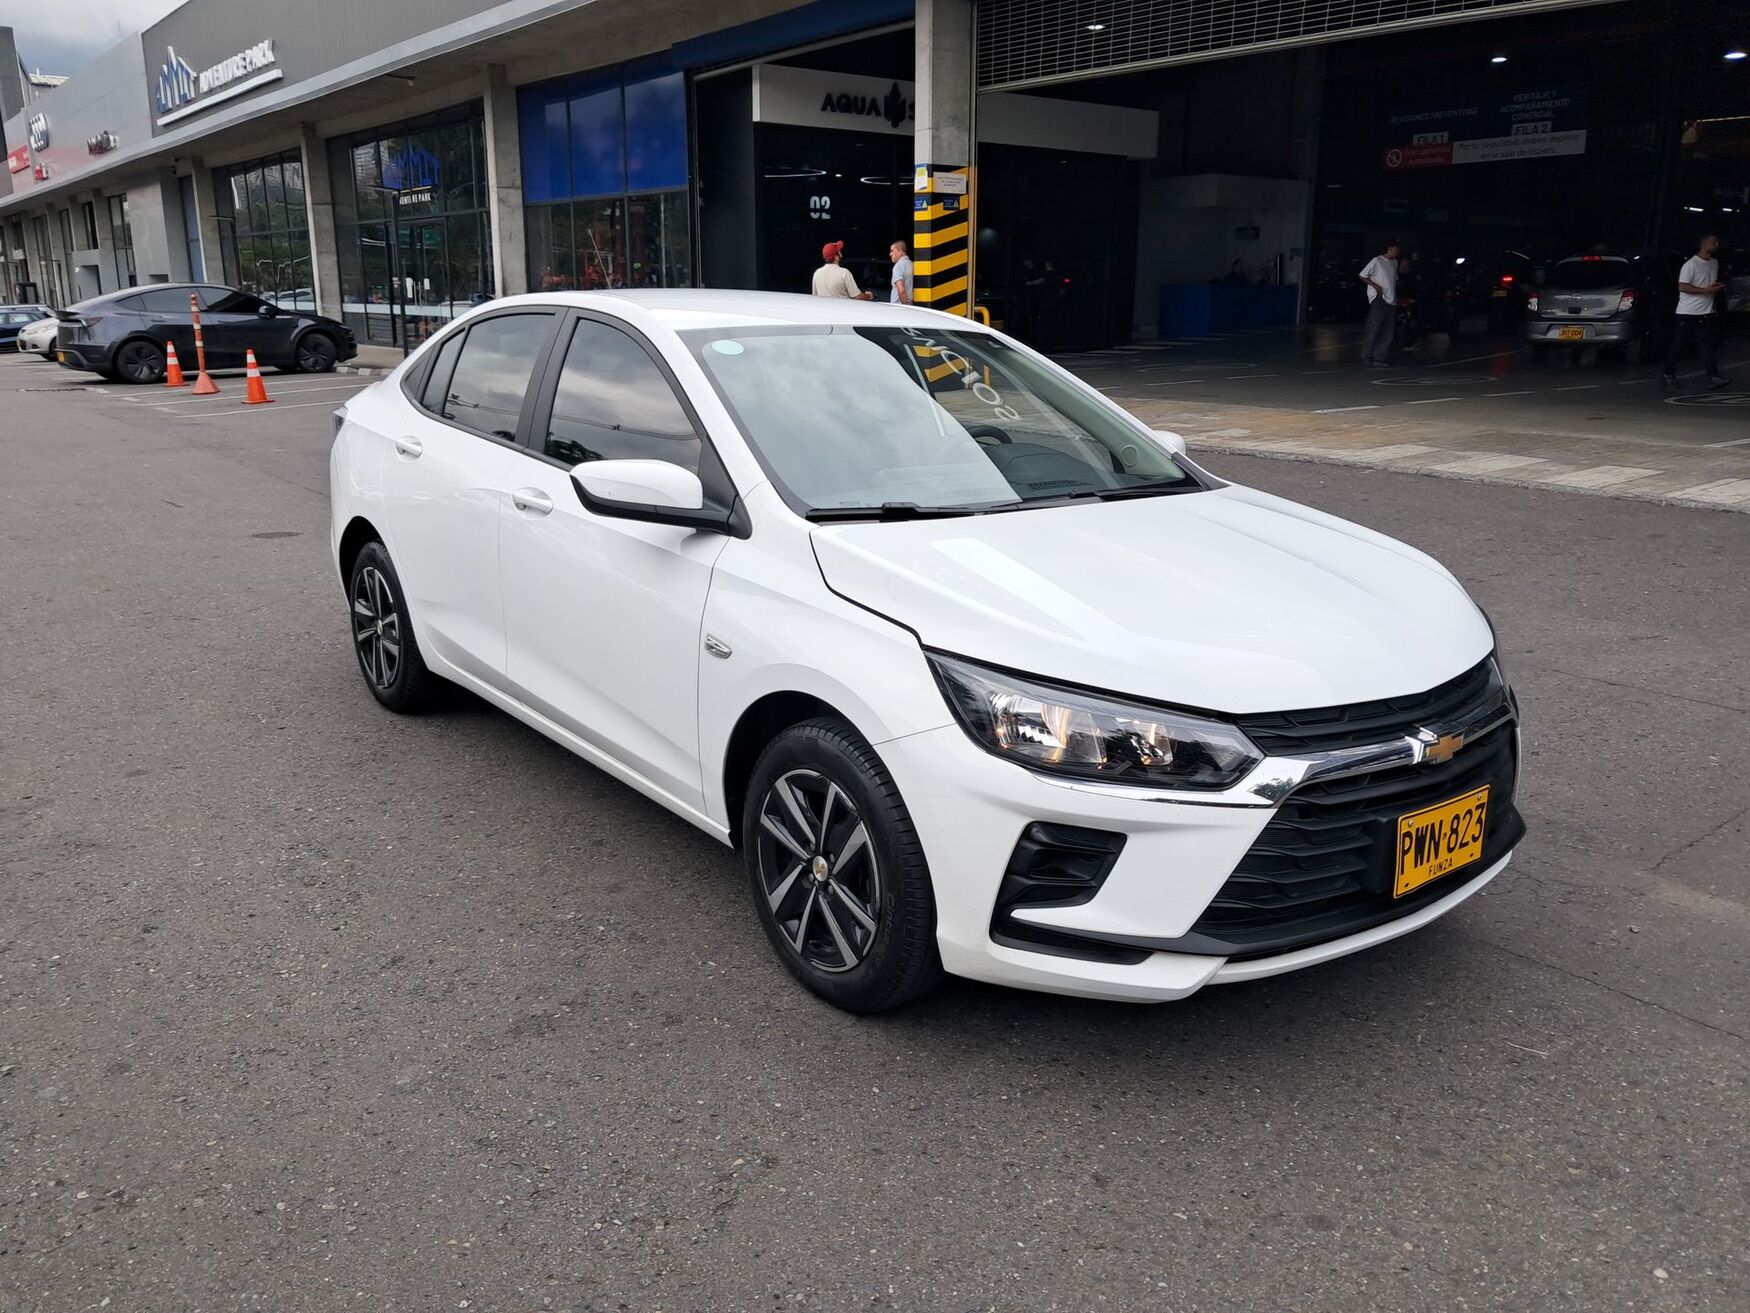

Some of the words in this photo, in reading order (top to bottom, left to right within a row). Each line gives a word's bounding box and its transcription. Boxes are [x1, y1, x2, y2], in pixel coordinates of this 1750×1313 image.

[820, 92, 882, 118] AQUA
[1416, 135, 1438, 145] FILA
[1515, 125, 1538, 136] FILA
[1541, 124, 1548, 134] 2
[809, 195, 831, 220] 02
[1428, 857, 1453, 877] FUNZA
